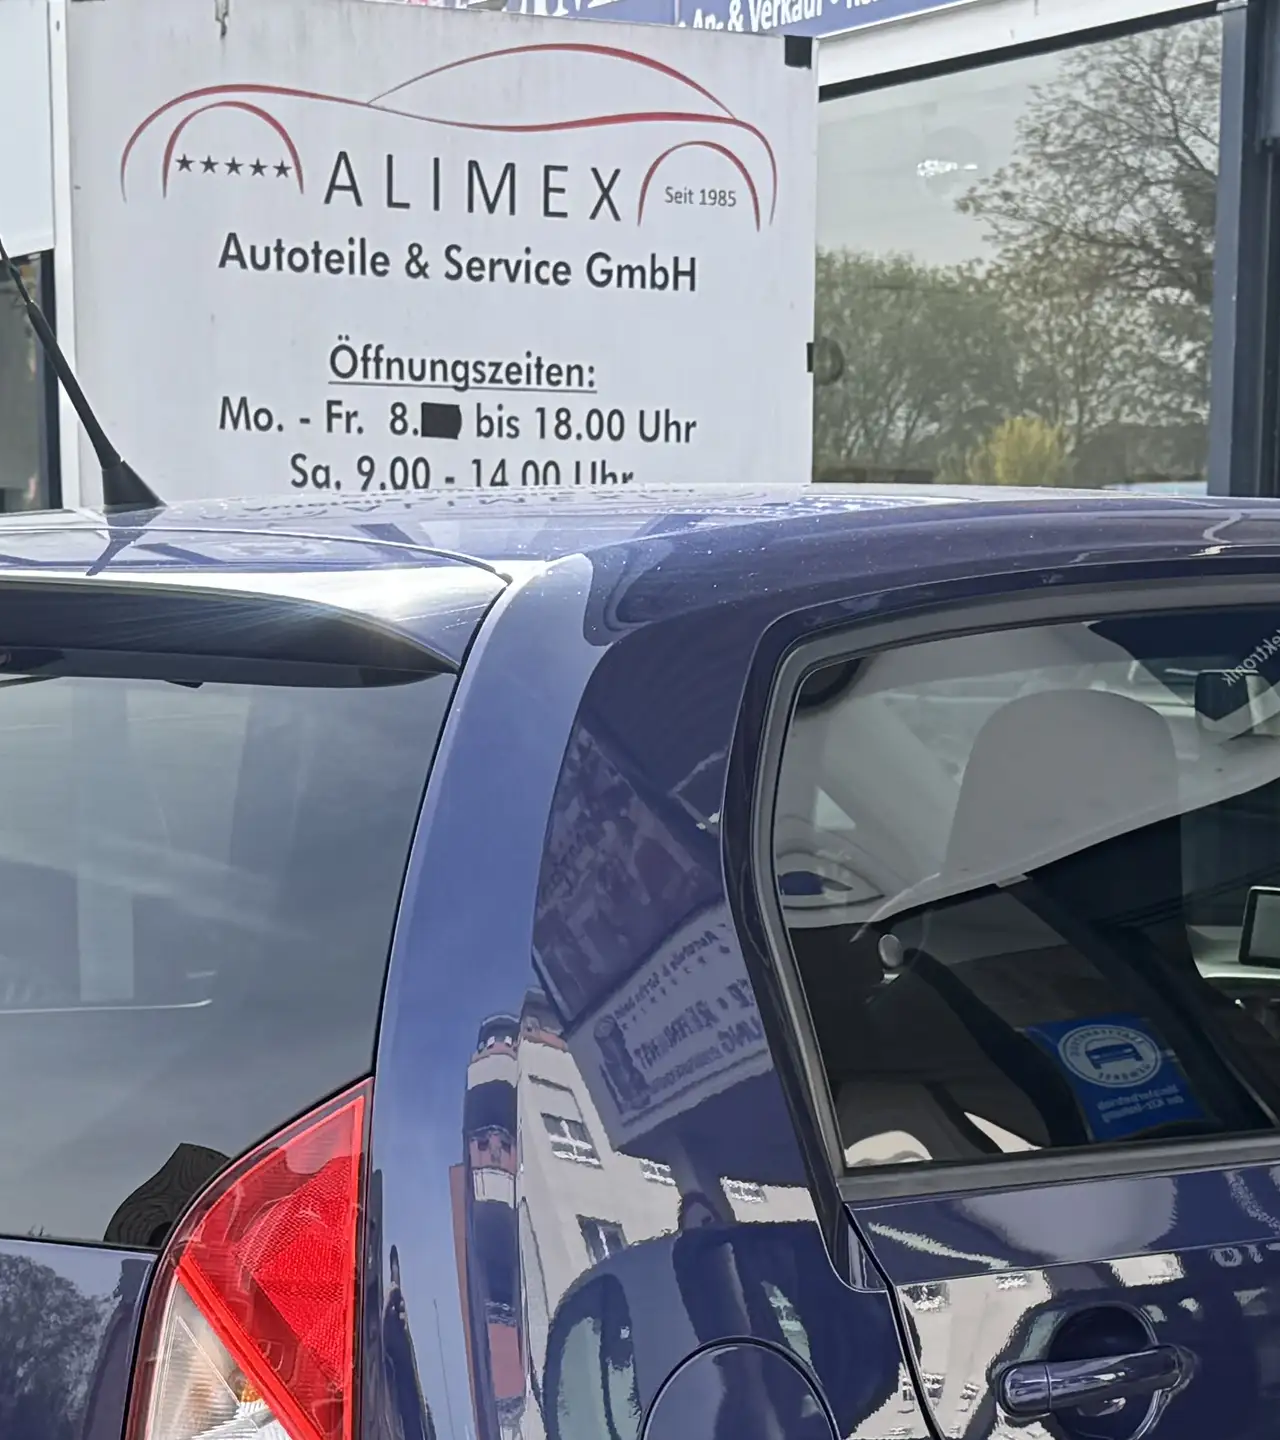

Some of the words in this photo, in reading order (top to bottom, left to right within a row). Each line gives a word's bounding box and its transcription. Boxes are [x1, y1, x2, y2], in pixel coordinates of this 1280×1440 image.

[323, 151, 621, 222] ALIMEX
[664, 186, 694, 205] Seit
[699, 188, 737, 208] 1985
[218, 233, 390, 278] Autoteile
[405, 242, 430, 280] &
[444, 243, 571, 286] Service
[586, 251, 697, 292] GmbH
[329, 335, 597, 392] Öffnungszeiten:
[219, 396, 283, 432] Mo.
[326, 400, 364, 434] Fr.
[476, 402, 520, 439] bis
[535, 406, 626, 442] 18.00
[639, 408, 697, 443] Uhr
[290, 453, 341, 490] Sa.
[357, 455, 431, 491] 9.00
